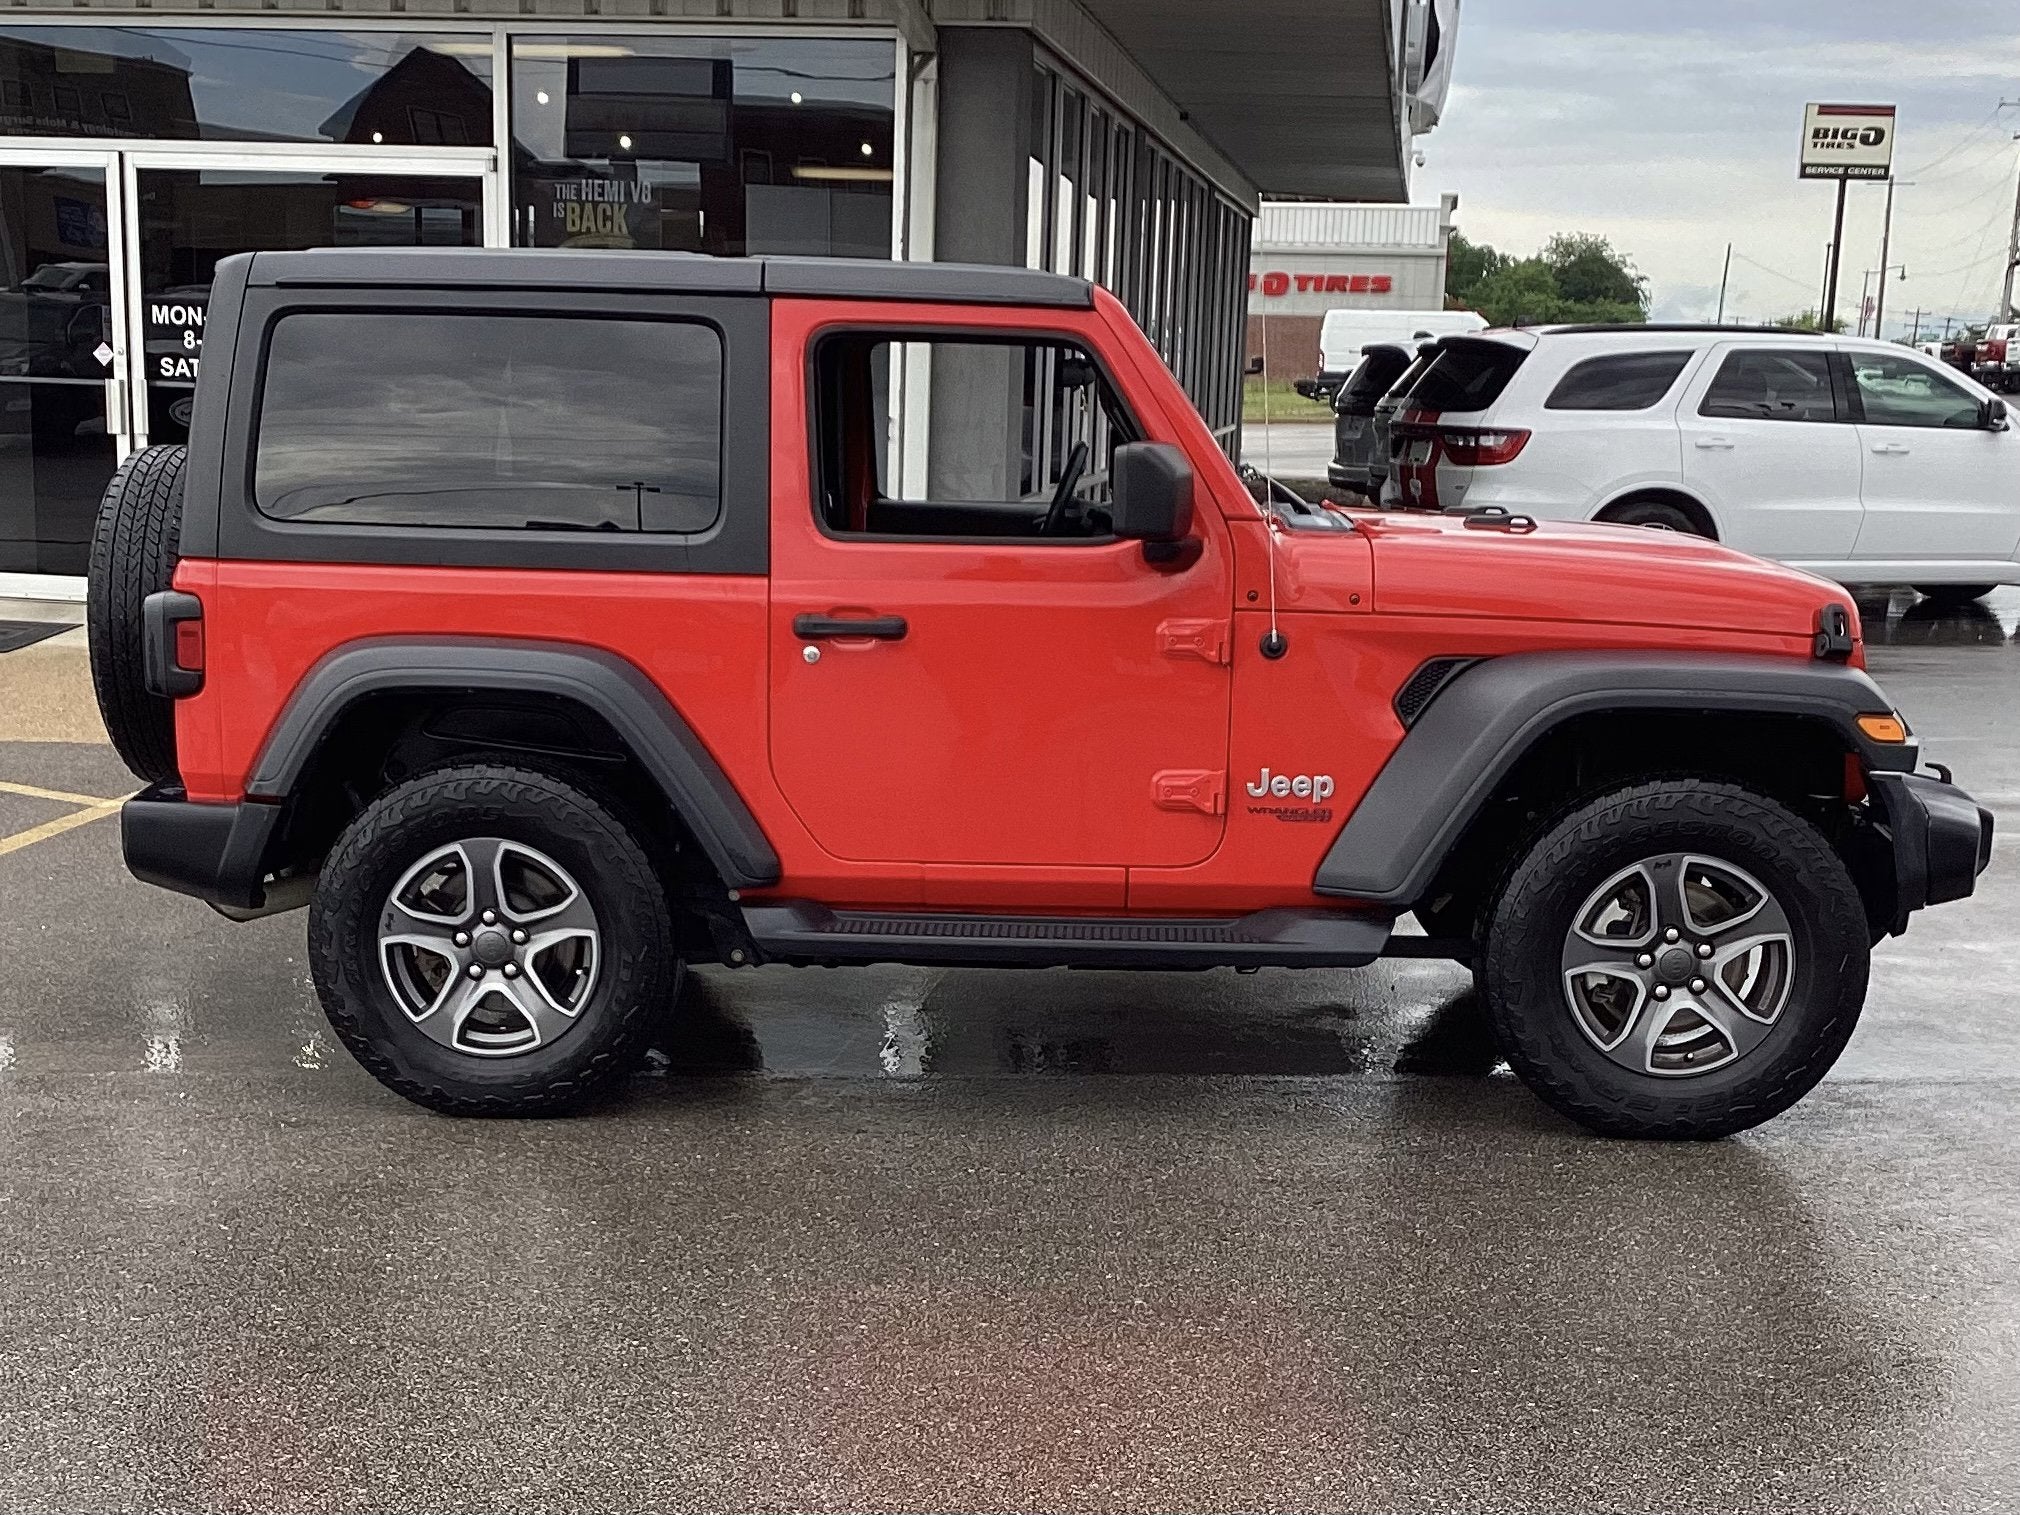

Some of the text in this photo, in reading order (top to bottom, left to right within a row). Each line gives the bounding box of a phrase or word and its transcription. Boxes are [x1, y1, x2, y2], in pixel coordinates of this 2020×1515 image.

[1811, 127, 1860, 140] BIG
[1812, 141, 1856, 149] TIRES
[1805, 166, 1885, 176] SERVICE CENTER
[554, 179, 652, 203] THE HEMI V8
[553, 201, 629, 235] IS BACK
[1293, 274, 1393, 293] TIRES
[1246, 767, 1335, 804] Jeep
